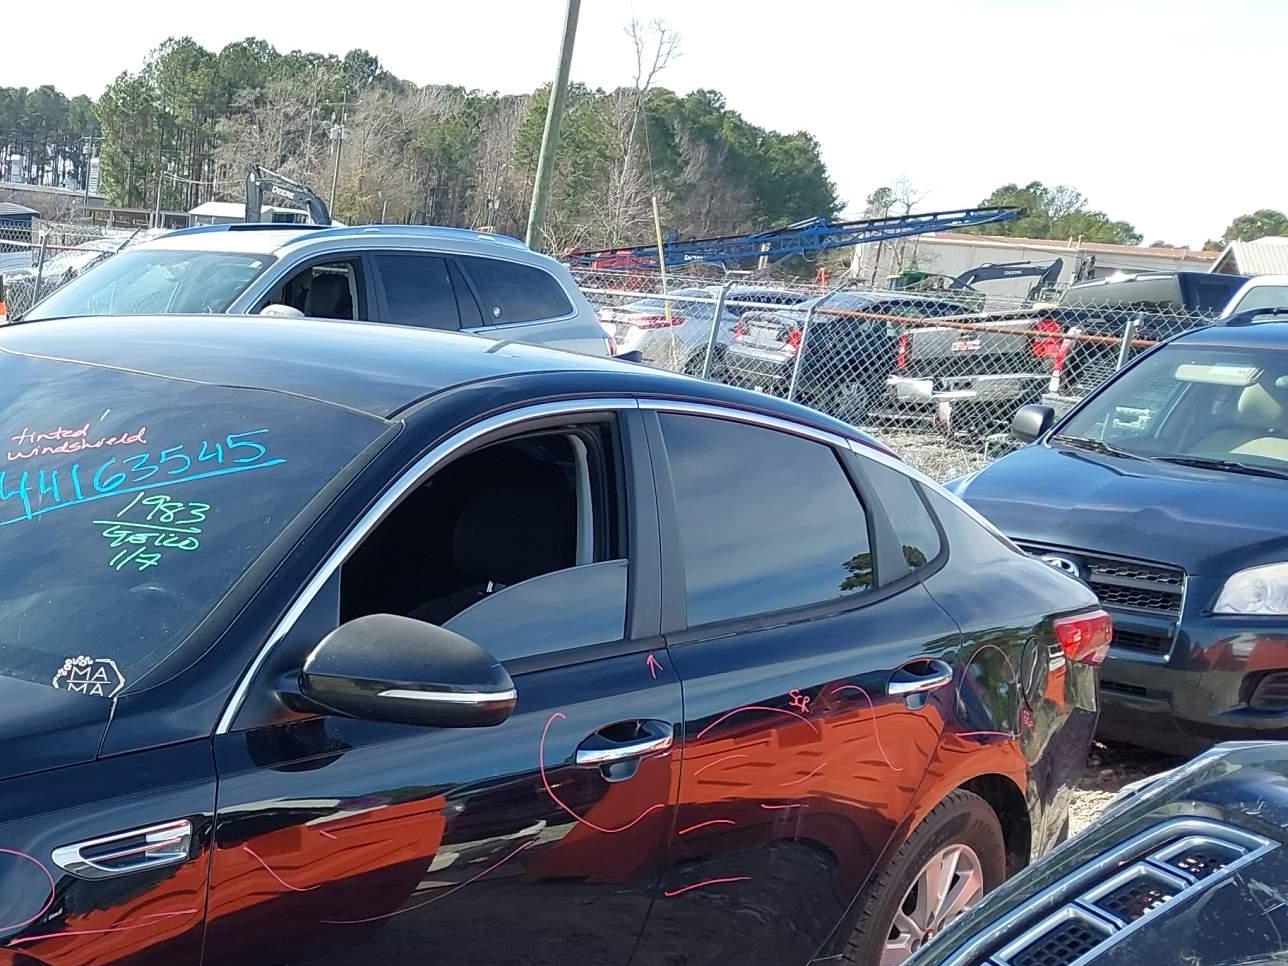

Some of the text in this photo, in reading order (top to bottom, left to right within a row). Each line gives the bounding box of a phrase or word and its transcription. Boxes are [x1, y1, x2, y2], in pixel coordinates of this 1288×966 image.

[11, 423, 90, 446] tinted
[116, 491, 211, 525] 1983
[70, 666, 108, 681] MA
